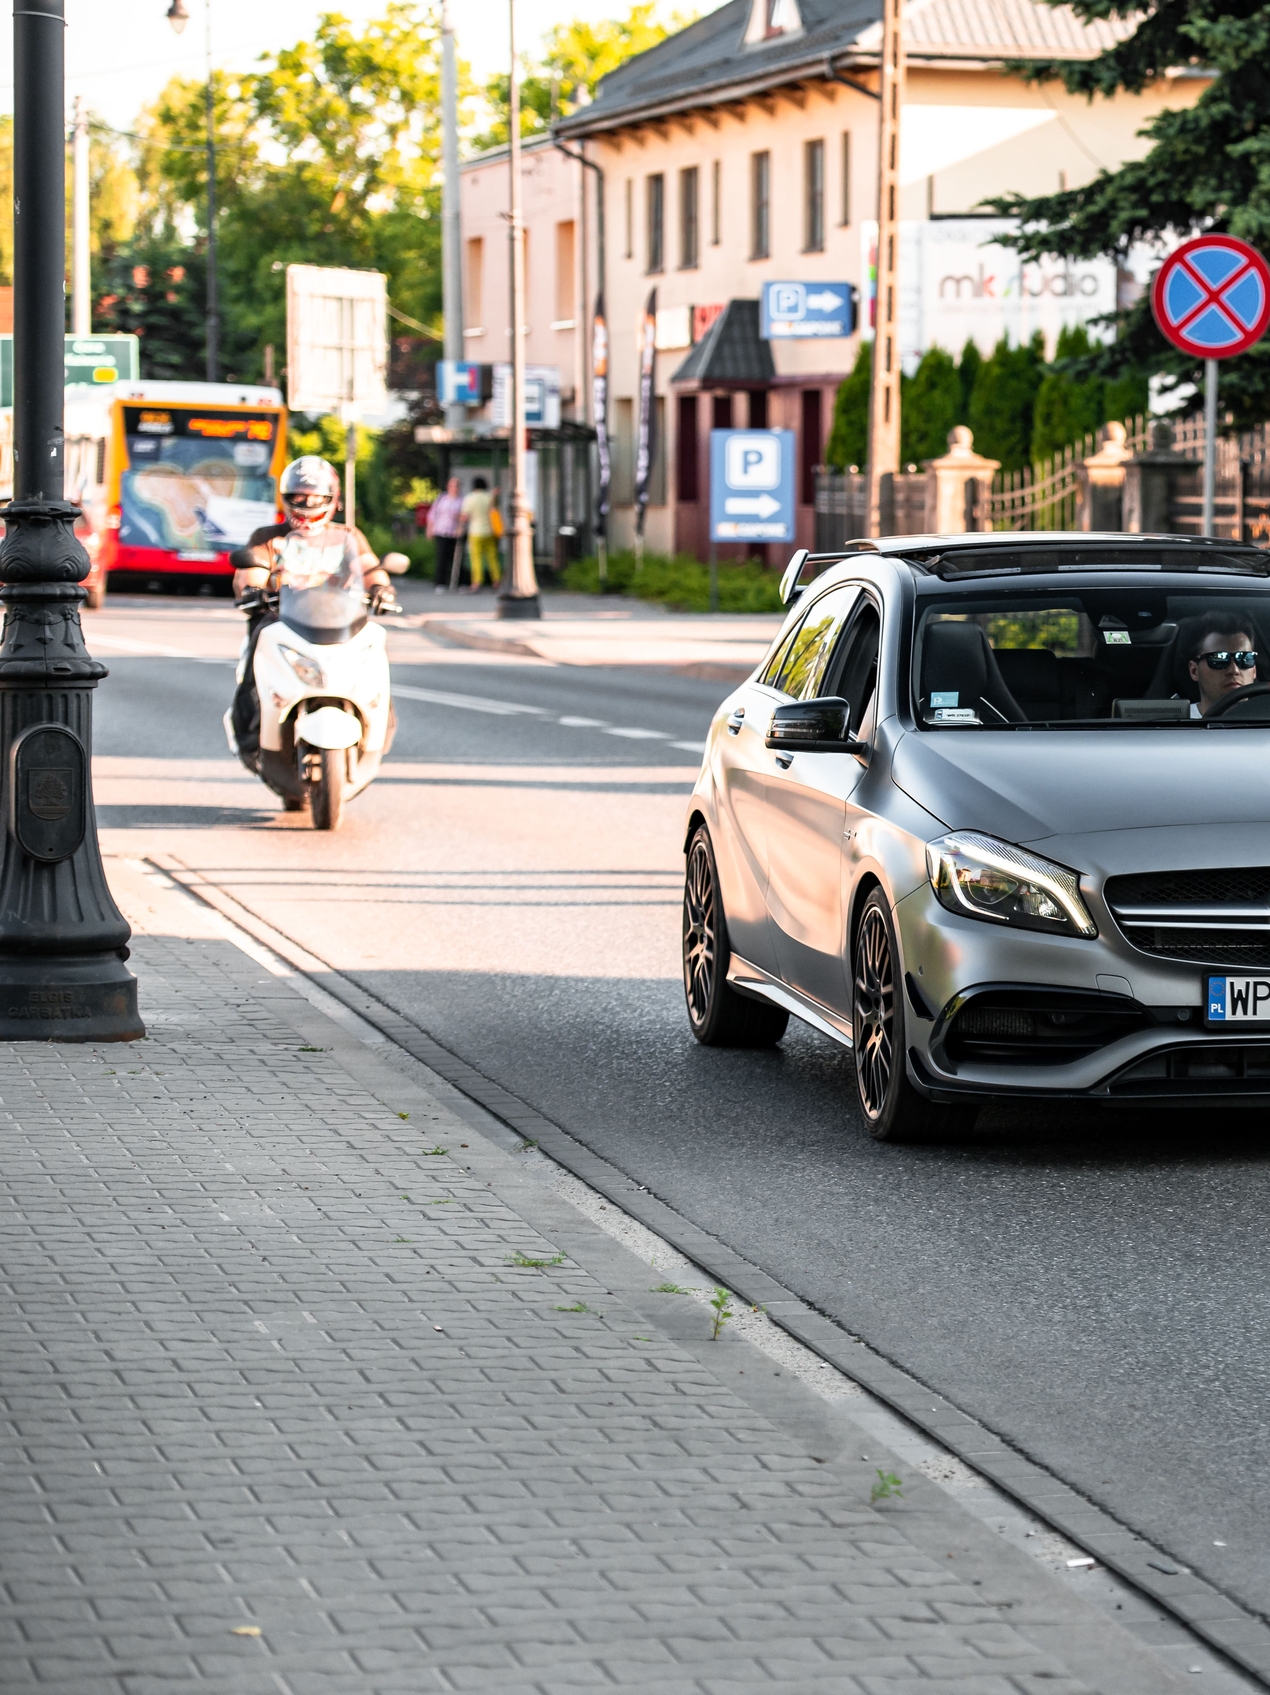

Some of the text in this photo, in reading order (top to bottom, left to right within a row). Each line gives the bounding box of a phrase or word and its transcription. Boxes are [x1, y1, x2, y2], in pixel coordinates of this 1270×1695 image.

[939, 262, 997, 298] mk
[741, 449, 764, 475] P
[1210, 1003, 1224, 1014] PL
